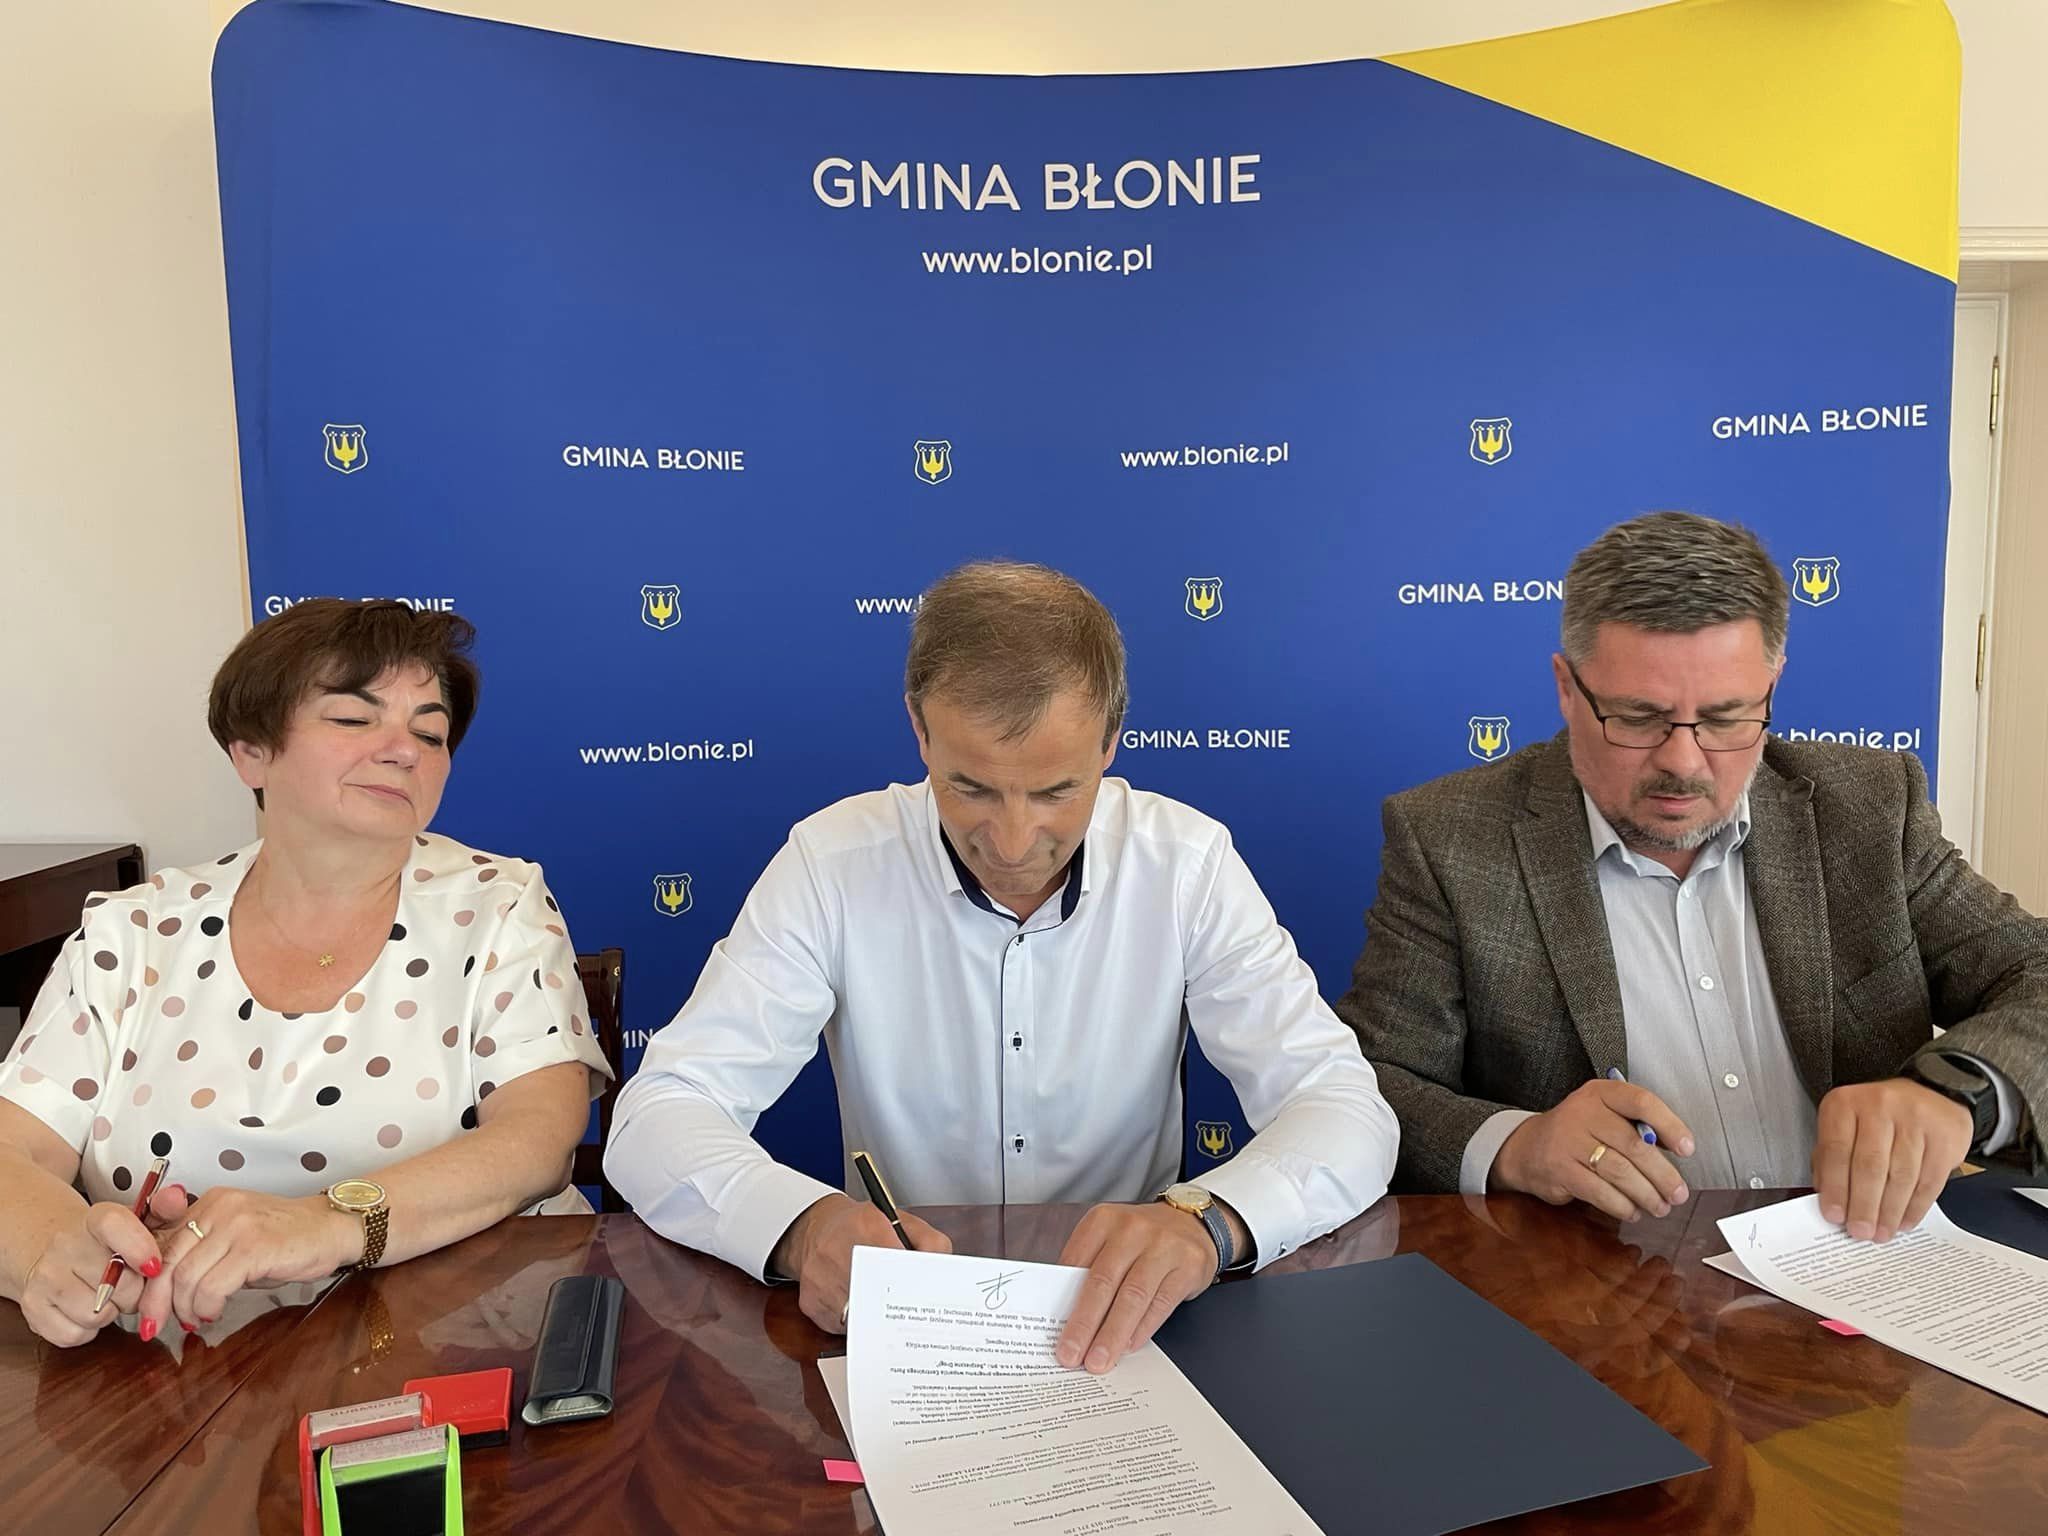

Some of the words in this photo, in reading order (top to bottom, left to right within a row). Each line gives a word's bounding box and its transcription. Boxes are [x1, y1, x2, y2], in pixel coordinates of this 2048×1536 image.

[813, 158, 1020, 210] GMINA
[1045, 155, 1260, 210] BŁONIE
[922, 244, 1152, 275] www.blonie.pl
[1712, 412, 1810, 439] GMINA
[1822, 405, 1928, 432] BŁONIE
[563, 445, 649, 468] GMINA
[658, 448, 744, 471] BŁONIE
[1120, 442, 1288, 467] www.blonie.pl
[1398, 582, 1484, 604] GMINA
[1493, 579, 1563, 602] BŁON
[580, 740, 753, 763] www.blonie.pl
[1122, 730, 1199, 749] GMINA
[1207, 729, 1290, 749] BŁONIE
